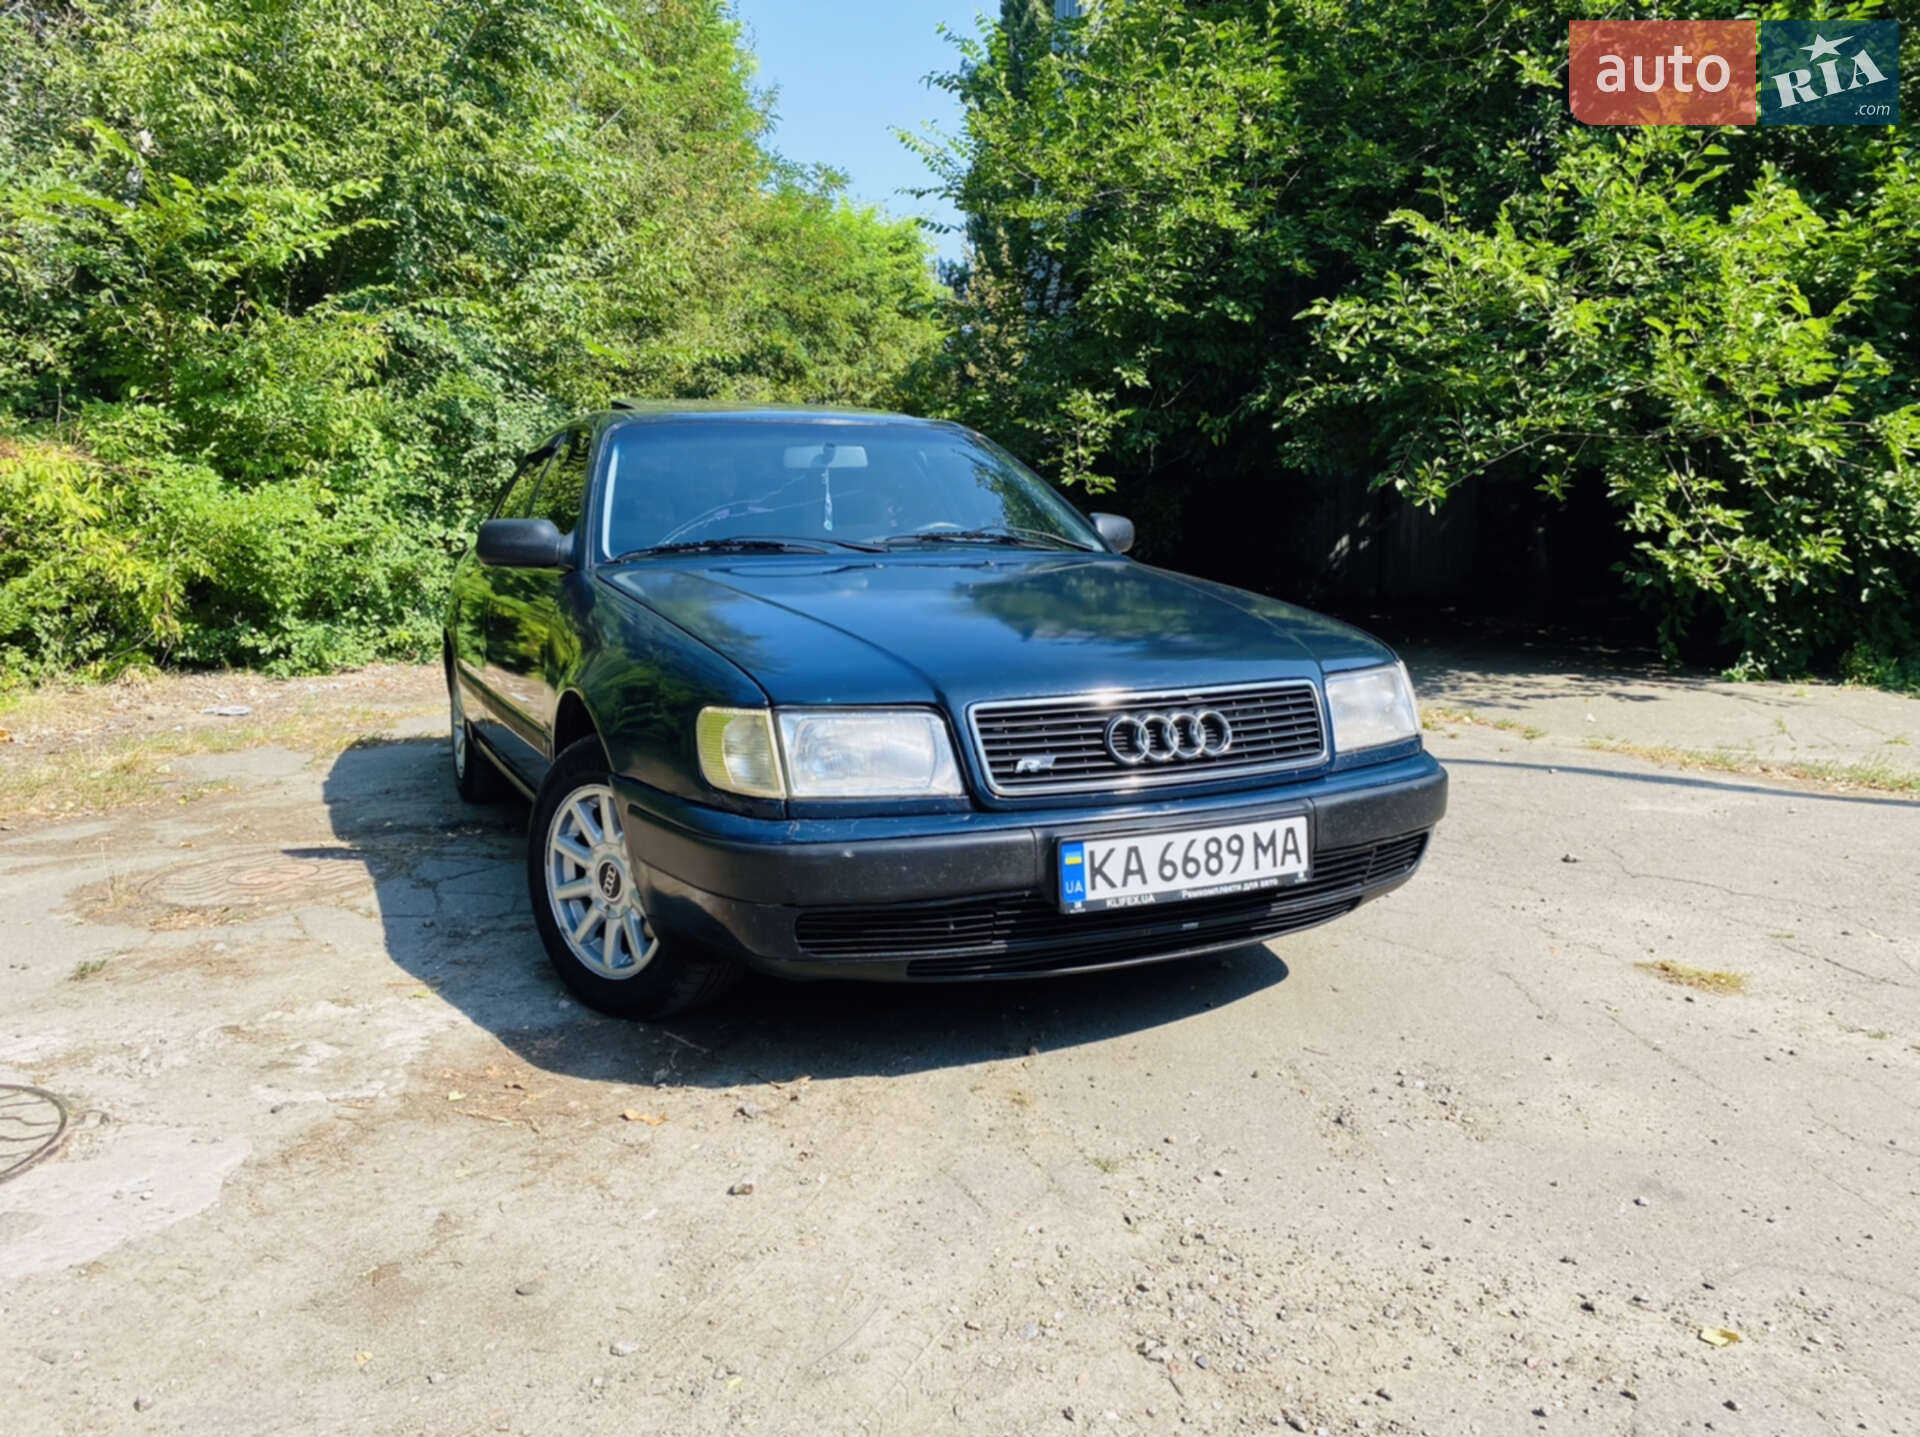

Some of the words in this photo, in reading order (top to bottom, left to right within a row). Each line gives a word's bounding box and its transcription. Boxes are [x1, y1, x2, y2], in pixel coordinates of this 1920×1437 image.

[1089, 845, 1148, 891] KA
[1158, 833, 1244, 882] 6689
[1253, 826, 1302, 870] MA
[1065, 880, 1084, 894] UA
